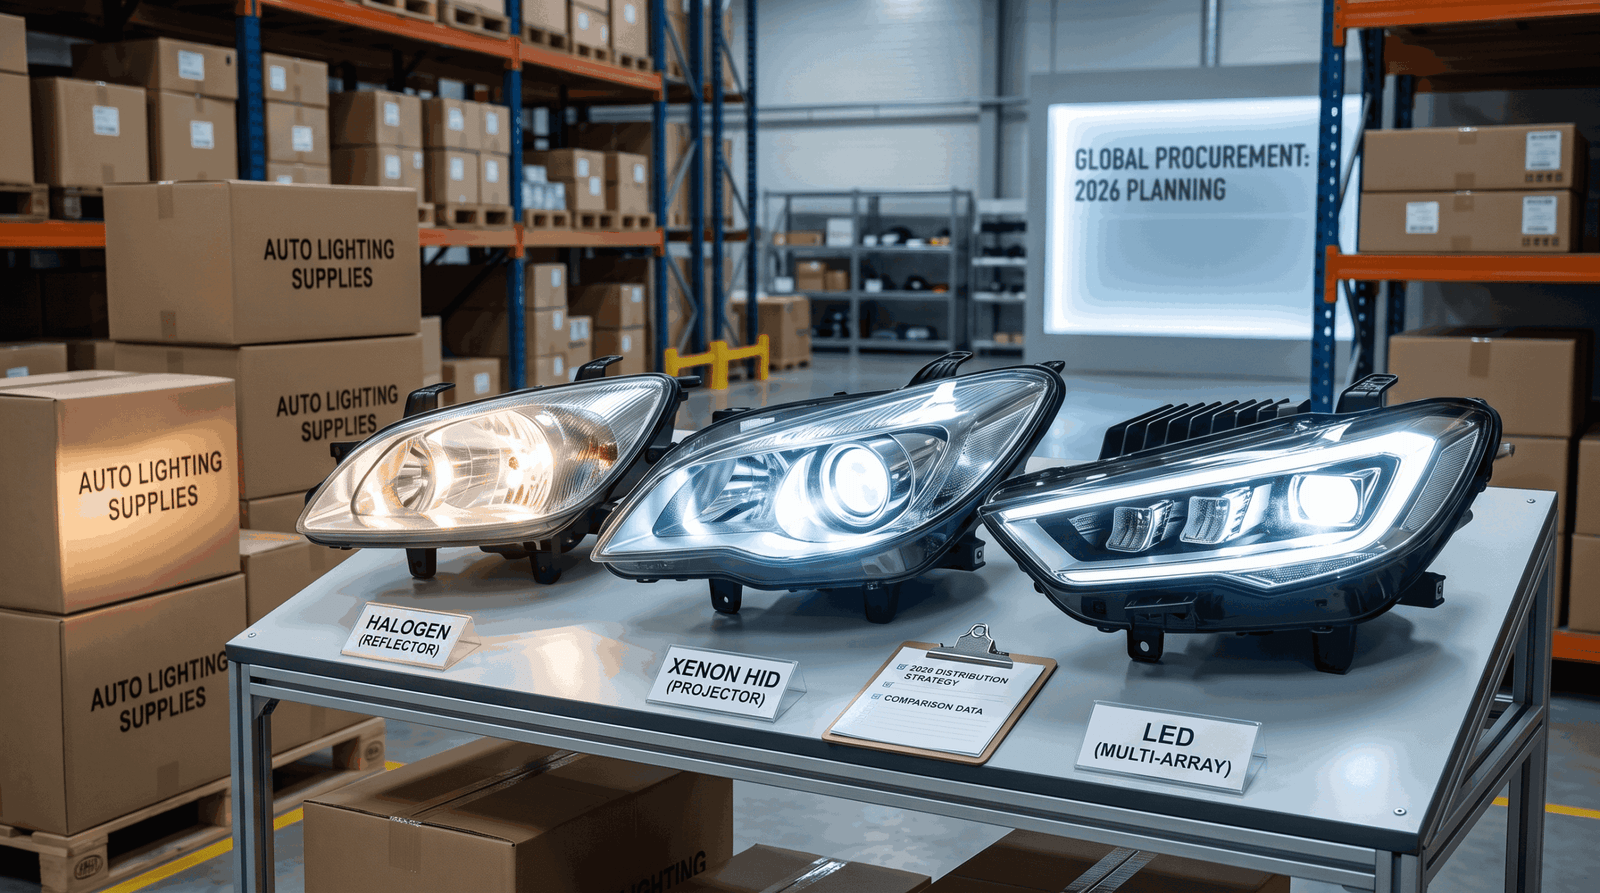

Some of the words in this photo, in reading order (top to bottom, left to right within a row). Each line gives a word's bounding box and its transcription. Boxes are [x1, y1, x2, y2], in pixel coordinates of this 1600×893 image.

[1075, 147, 1149, 170] GLOBAL
[1155, 143, 1310, 169] PROCUREMENT:
[1075, 178, 1121, 201] 2026
[1127, 177, 1227, 201] PLANNING
[264, 238, 312, 260] AUTO
[318, 238, 394, 260] LIGHTING
[292, 267, 373, 290] SUPPLIES
[276, 392, 321, 417] AUTO
[326, 384, 398, 411] LIGHTING
[301, 413, 377, 442] SUPPLIES
[79, 465, 131, 495] AUTO
[139, 450, 222, 484] LIGHTING
[108, 484, 198, 521] SUPPLIES
[365, 614, 452, 640] HALOGEN
[358, 634, 440, 658] (REFLECTOR)
[91, 676, 142, 712] AUTO
[148, 650, 228, 694] LIGHTING
[667, 657, 741, 683] XENON
[743, 668, 781, 688] HID
[904, 673, 960, 687] STRATEGY
[935, 668, 1009, 684] DISTRIBUTION
[666, 680, 765, 708] (PROJECTOR)
[884, 694, 954, 711] COMPARISON
[955, 705, 983, 715] DATA
[119, 686, 206, 733] SUPPLIES
[1142, 722, 1194, 747] LED
[1094, 742, 1232, 779] (MULTI-ARRAY)
